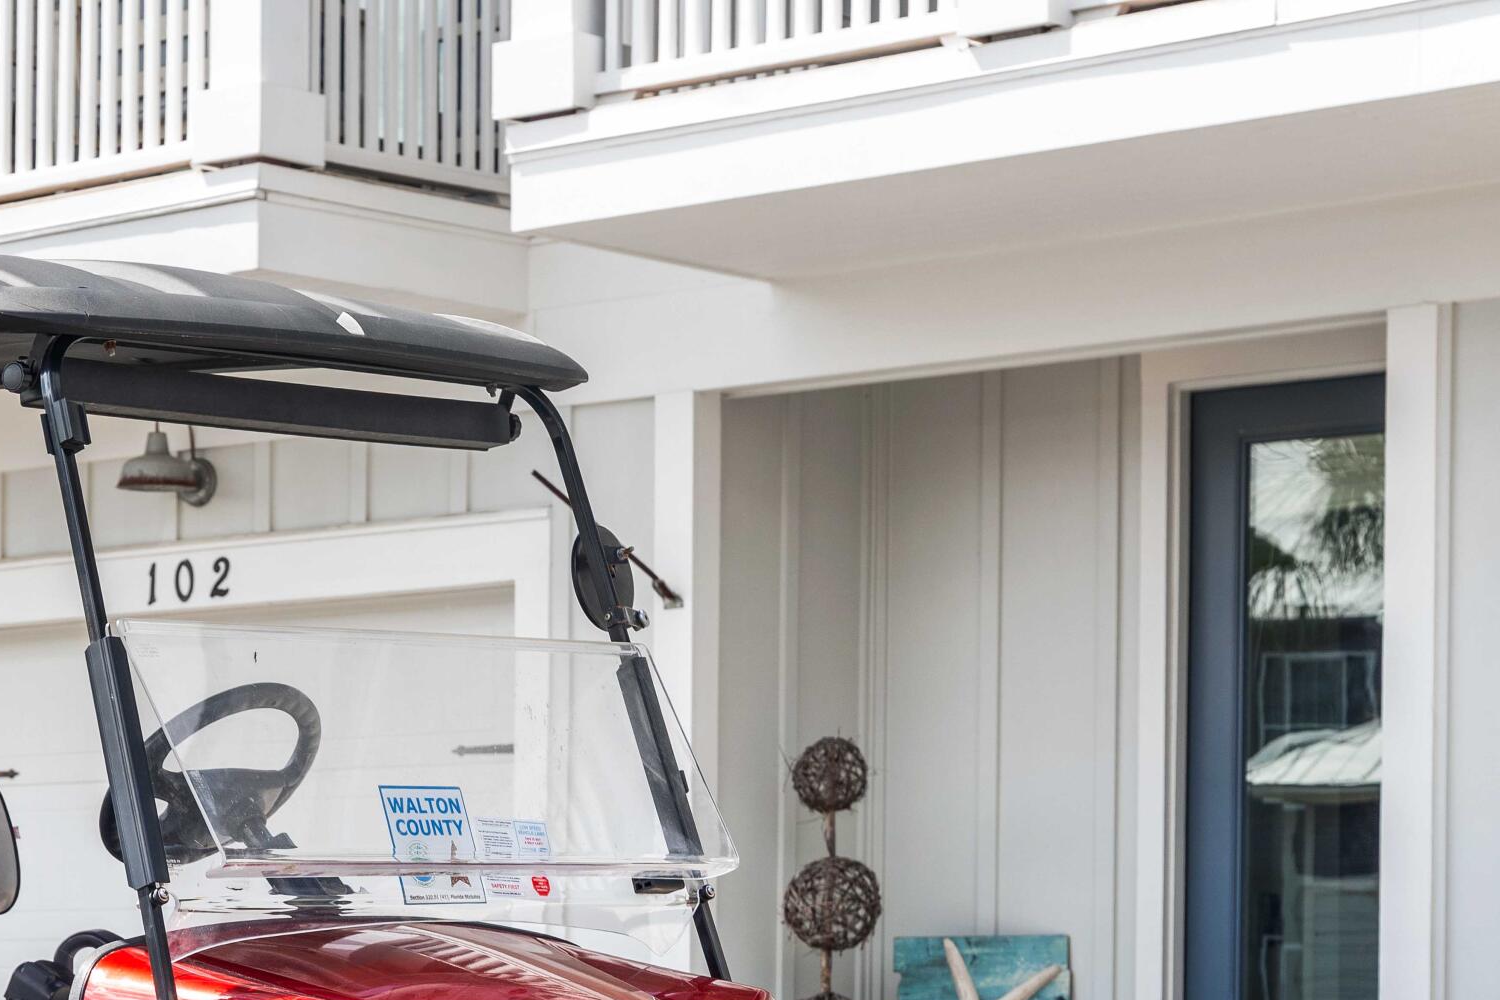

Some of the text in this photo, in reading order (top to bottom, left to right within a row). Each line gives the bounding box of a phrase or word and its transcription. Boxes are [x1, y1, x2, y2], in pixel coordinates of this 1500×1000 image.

[148, 556, 230, 606] 102
[386, 796, 462, 815] WALTON
[395, 818, 463, 837] COUNTY
